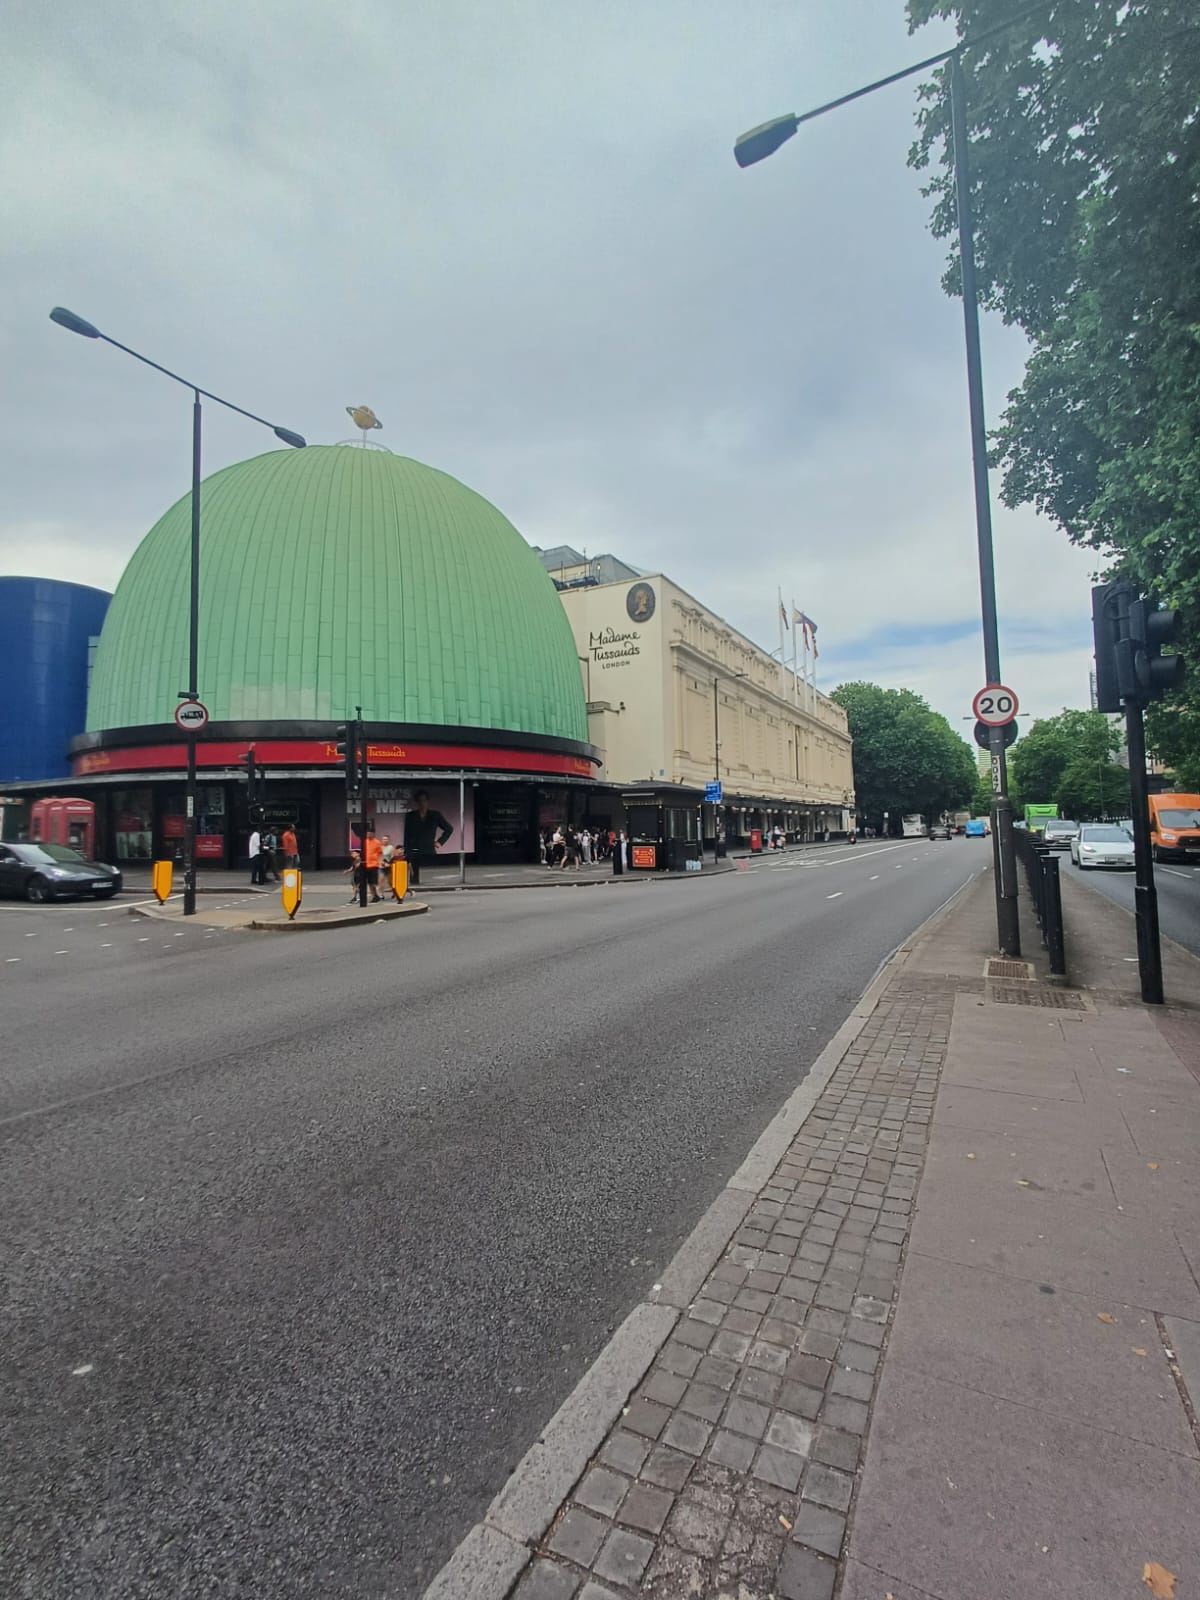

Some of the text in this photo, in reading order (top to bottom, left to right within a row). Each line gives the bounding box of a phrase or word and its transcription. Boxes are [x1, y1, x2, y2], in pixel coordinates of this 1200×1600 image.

[590, 627, 640, 647] Madame
[589, 641, 640, 661] Tussauds
[602, 661, 630, 669] LONDON
[980, 696, 1012, 714] 20
[367, 746, 406, 757] Tussauds
